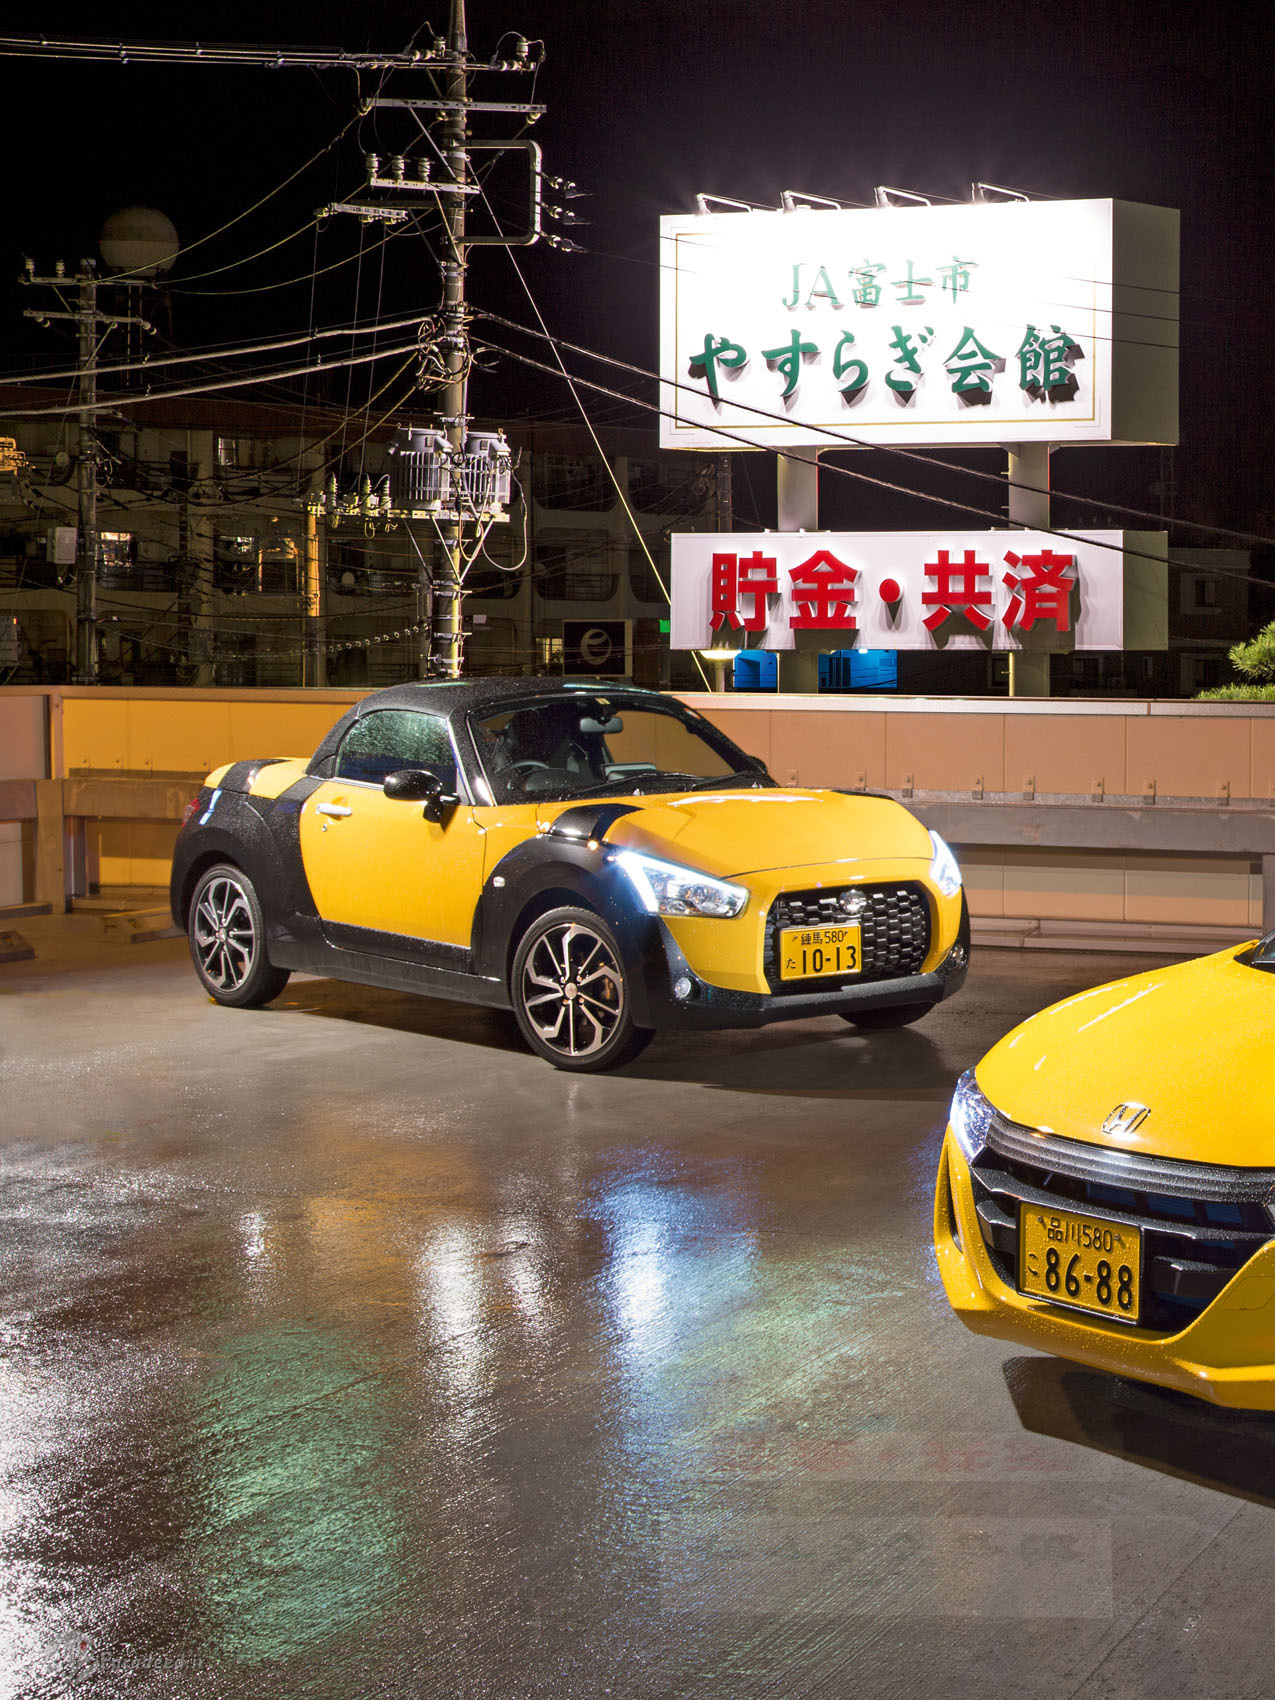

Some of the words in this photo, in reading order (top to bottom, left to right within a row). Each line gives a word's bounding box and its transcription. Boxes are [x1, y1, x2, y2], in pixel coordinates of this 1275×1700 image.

[781, 256, 978, 310] JA富士市
[688, 323, 1078, 397] やすらぎ会館
[709, 549, 1078, 632] 貯金・共済
[786, 958, 797, 969] た
[802, 945, 857, 975] 10-13
[801, 931, 823, 946] 練馬
[824, 930, 844, 944] 580
[1047, 1217, 1080, 1247] 品川
[1082, 1223, 1113, 1253] 580
[1027, 1253, 1039, 1276] こ
[1045, 1247, 1133, 1310] 86-88
